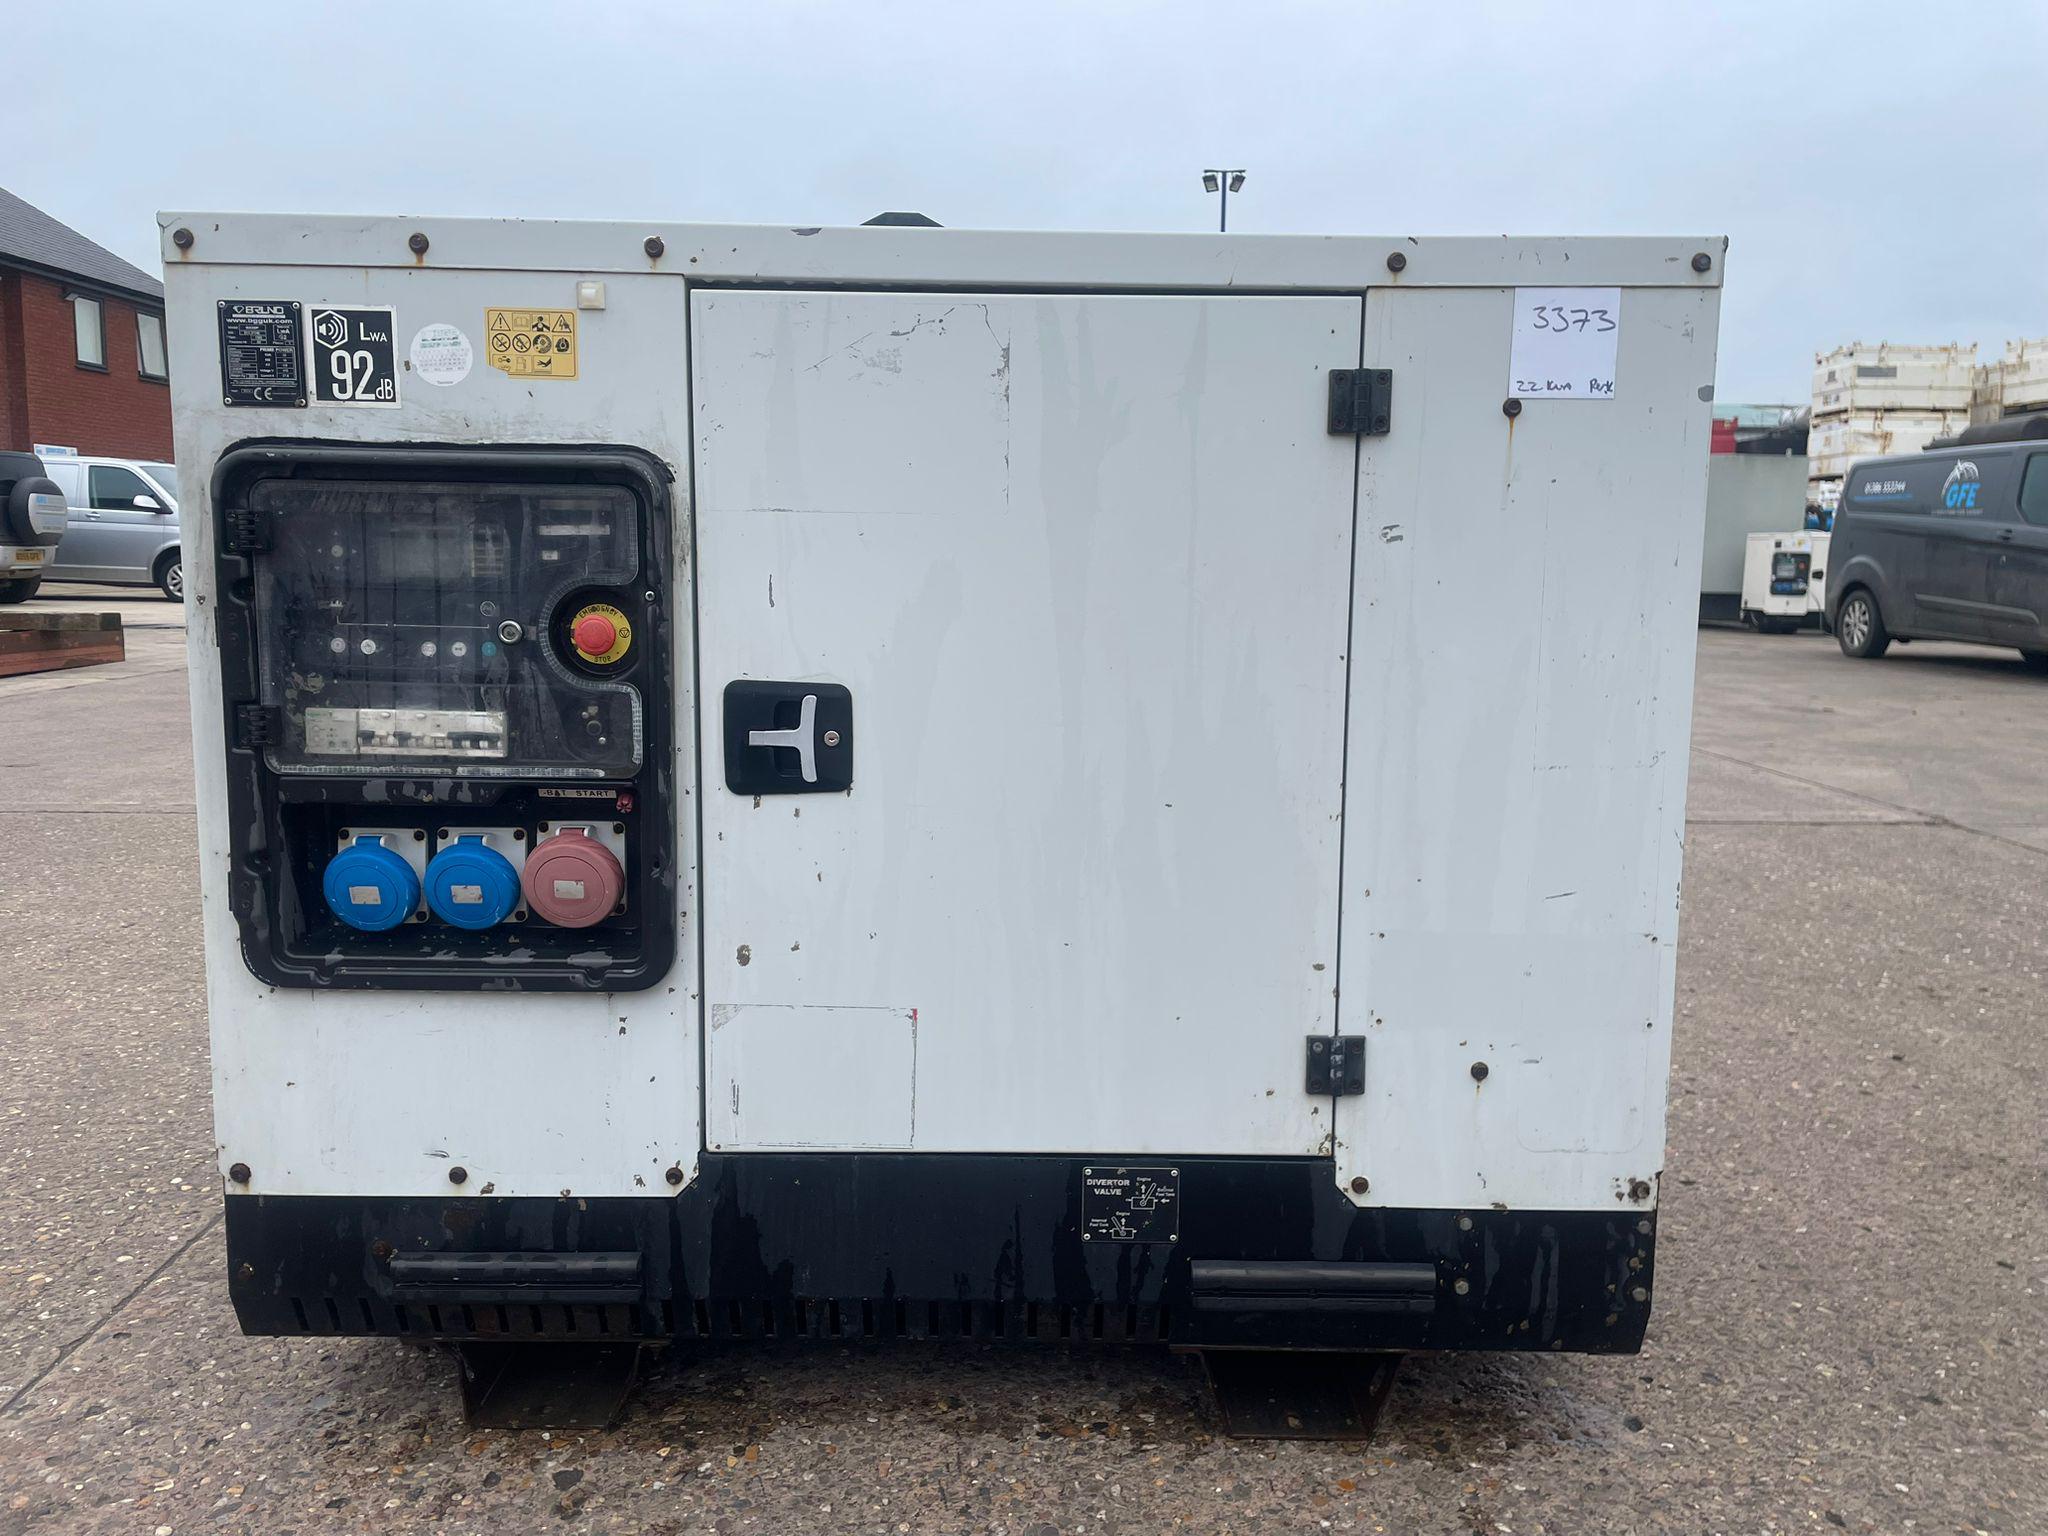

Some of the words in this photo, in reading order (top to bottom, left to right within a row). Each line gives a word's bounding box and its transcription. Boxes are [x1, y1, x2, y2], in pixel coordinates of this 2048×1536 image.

[246, 306, 284, 314] BRUNO
[1532, 305, 1616, 333] 3373
[330, 350, 376, 400] 92
[1516, 380, 1543, 392] 22
[1946, 482, 1981, 508] GFE
[578, 605, 619, 619] EMEGENCY
[594, 655, 612, 663] STOP
[1086, 1178, 1131, 1186] DIVERTOR
[1094, 1188, 1122, 1196] VALVE
